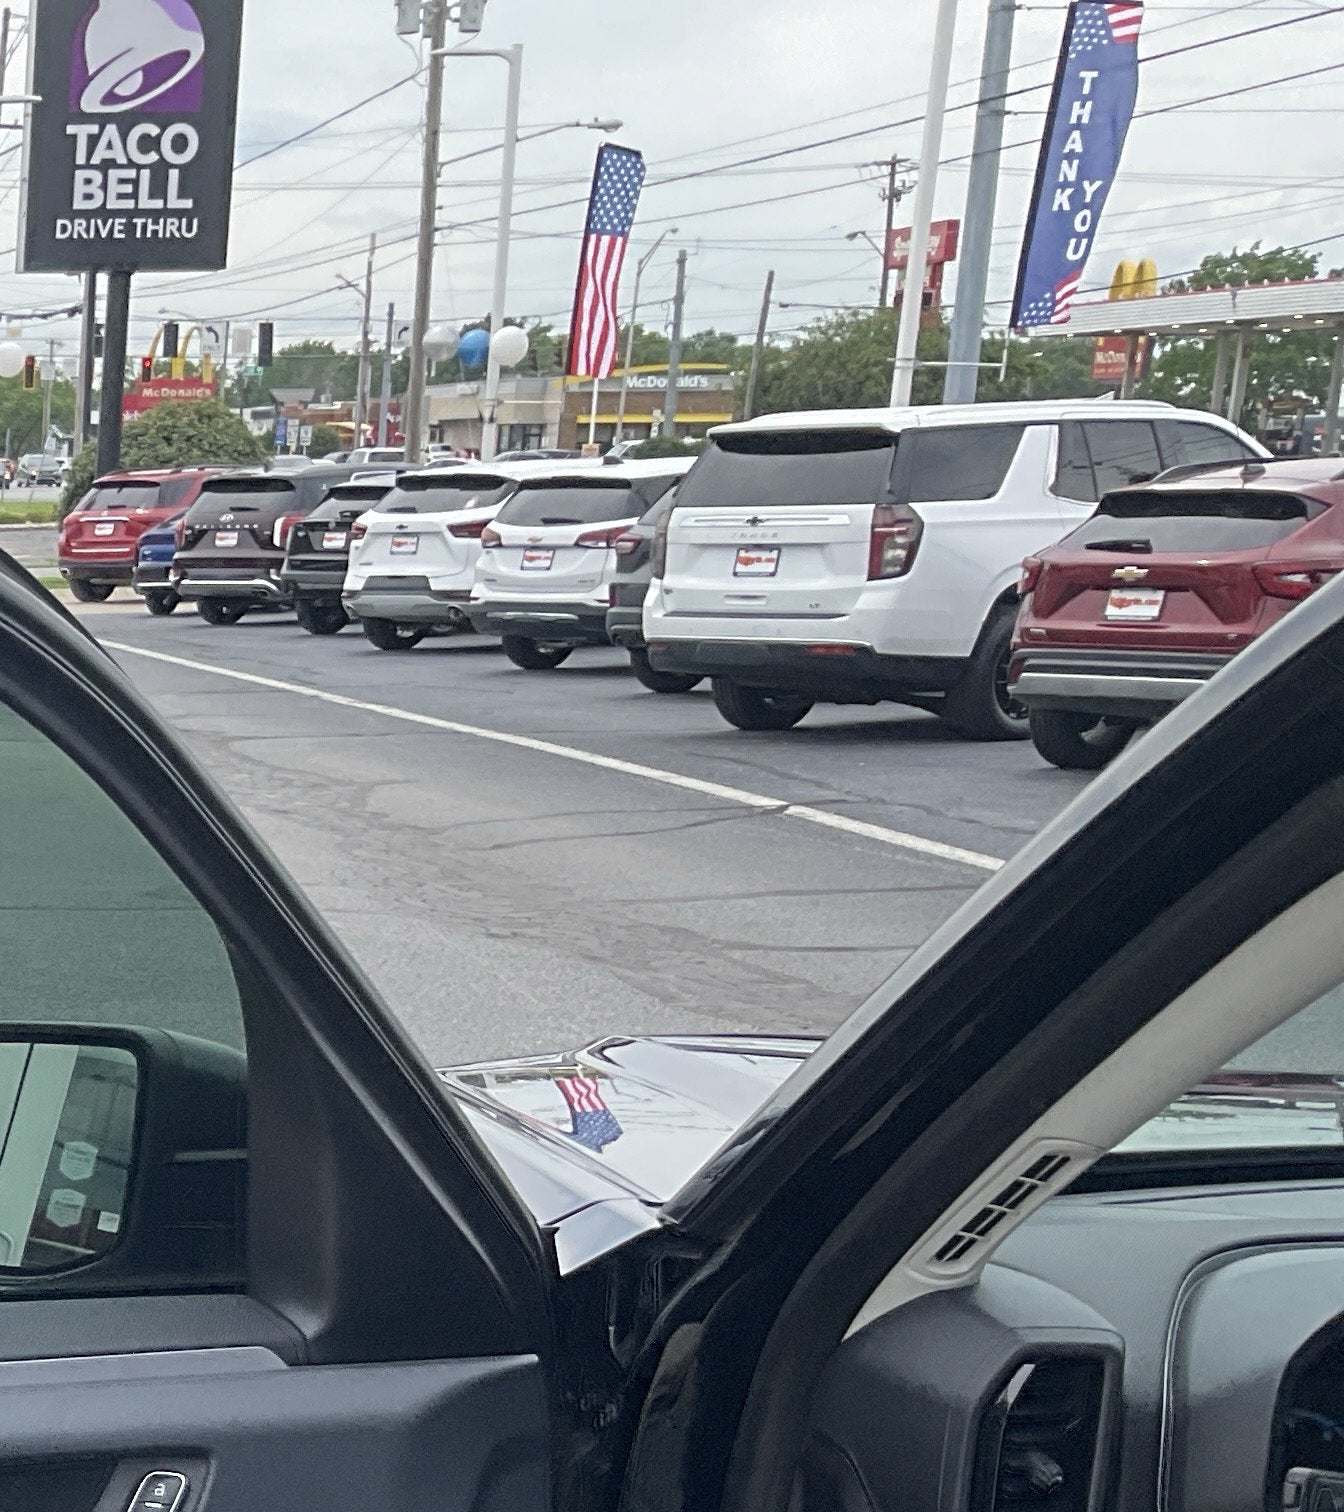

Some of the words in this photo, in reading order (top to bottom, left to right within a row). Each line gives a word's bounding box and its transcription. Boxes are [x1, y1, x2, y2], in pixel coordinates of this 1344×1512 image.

[65, 122, 199, 165] TACO
[1052, 71, 1099, 211] THANK
[72, 168, 193, 210] BELL
[55, 217, 127, 239] DRIVE
[132, 217, 199, 239] THRU
[1066, 180, 1103, 261] YOU
[142, 387, 212, 397] McDonald's
[626, 374, 709, 388] McDoald's
